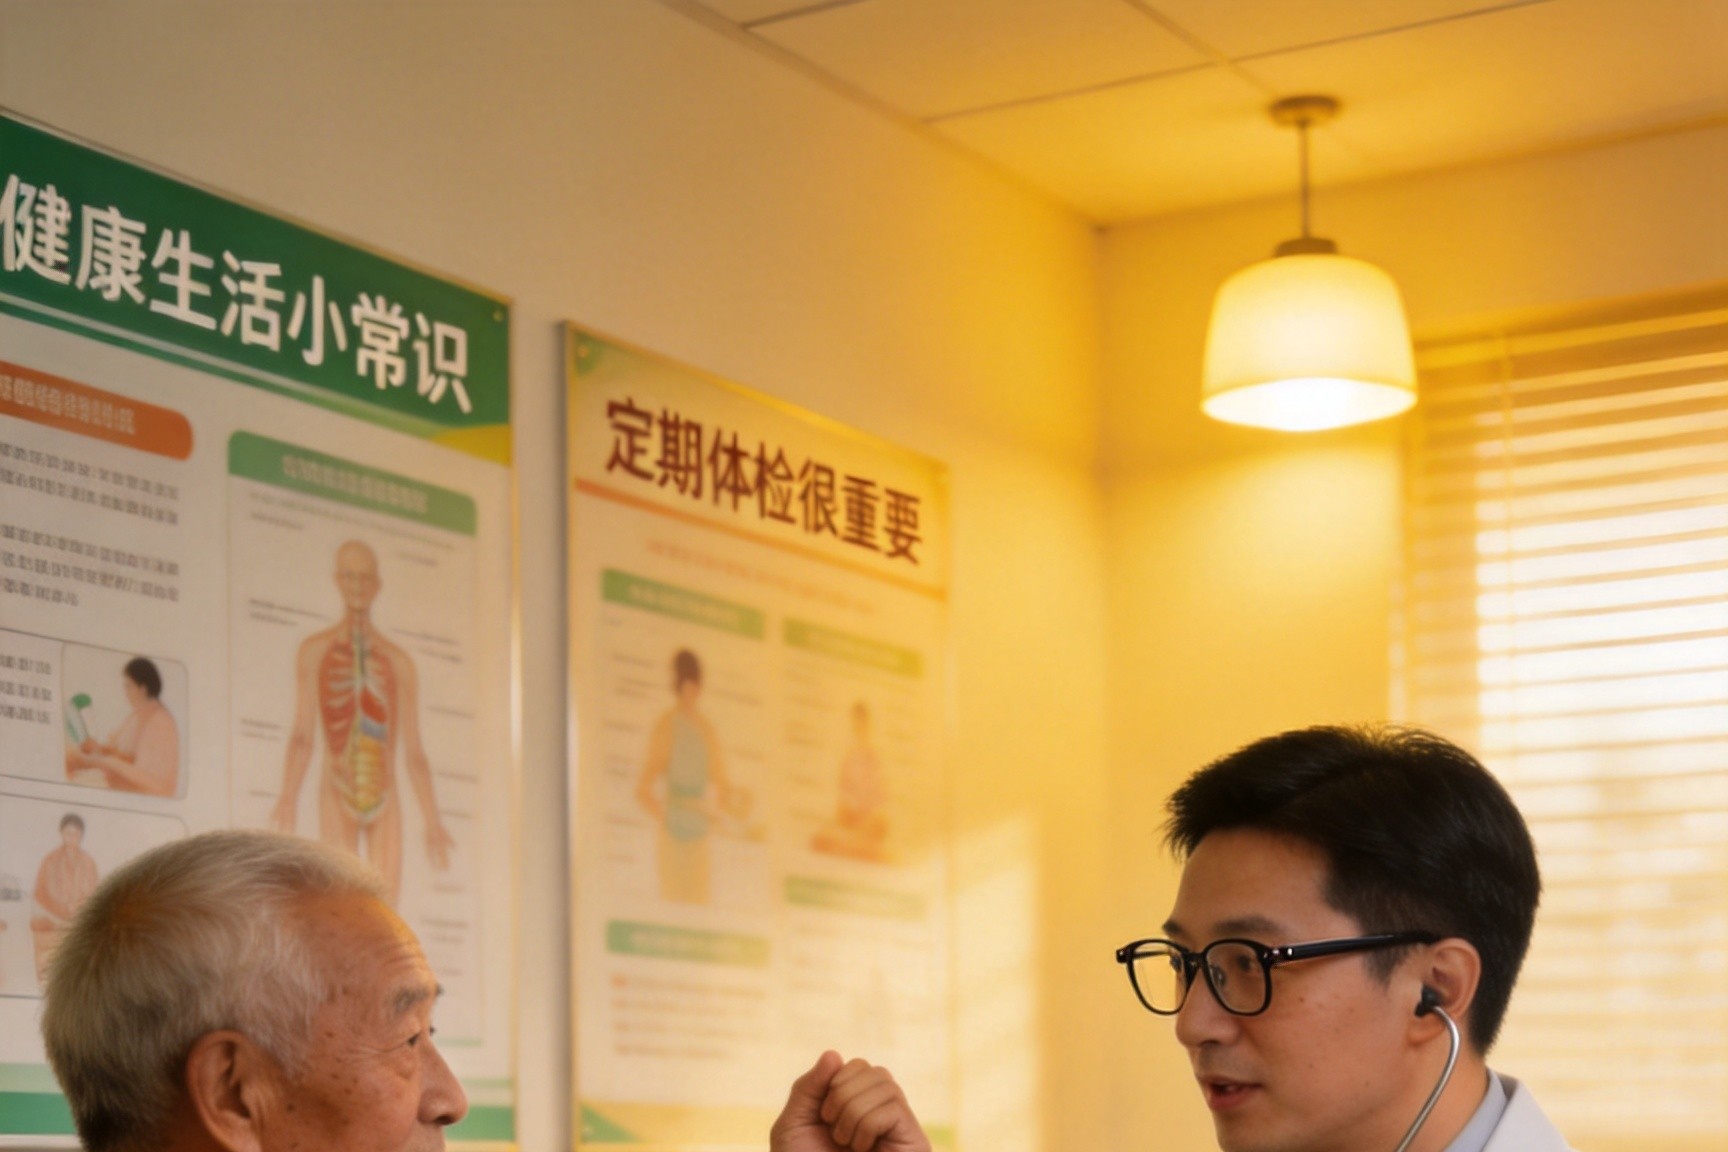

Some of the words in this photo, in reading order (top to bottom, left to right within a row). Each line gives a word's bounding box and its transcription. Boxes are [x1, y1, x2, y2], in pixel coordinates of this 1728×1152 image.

[0, 173, 472, 414] 健康生活小常识
[605, 397, 923, 566] 定期体检很重要
